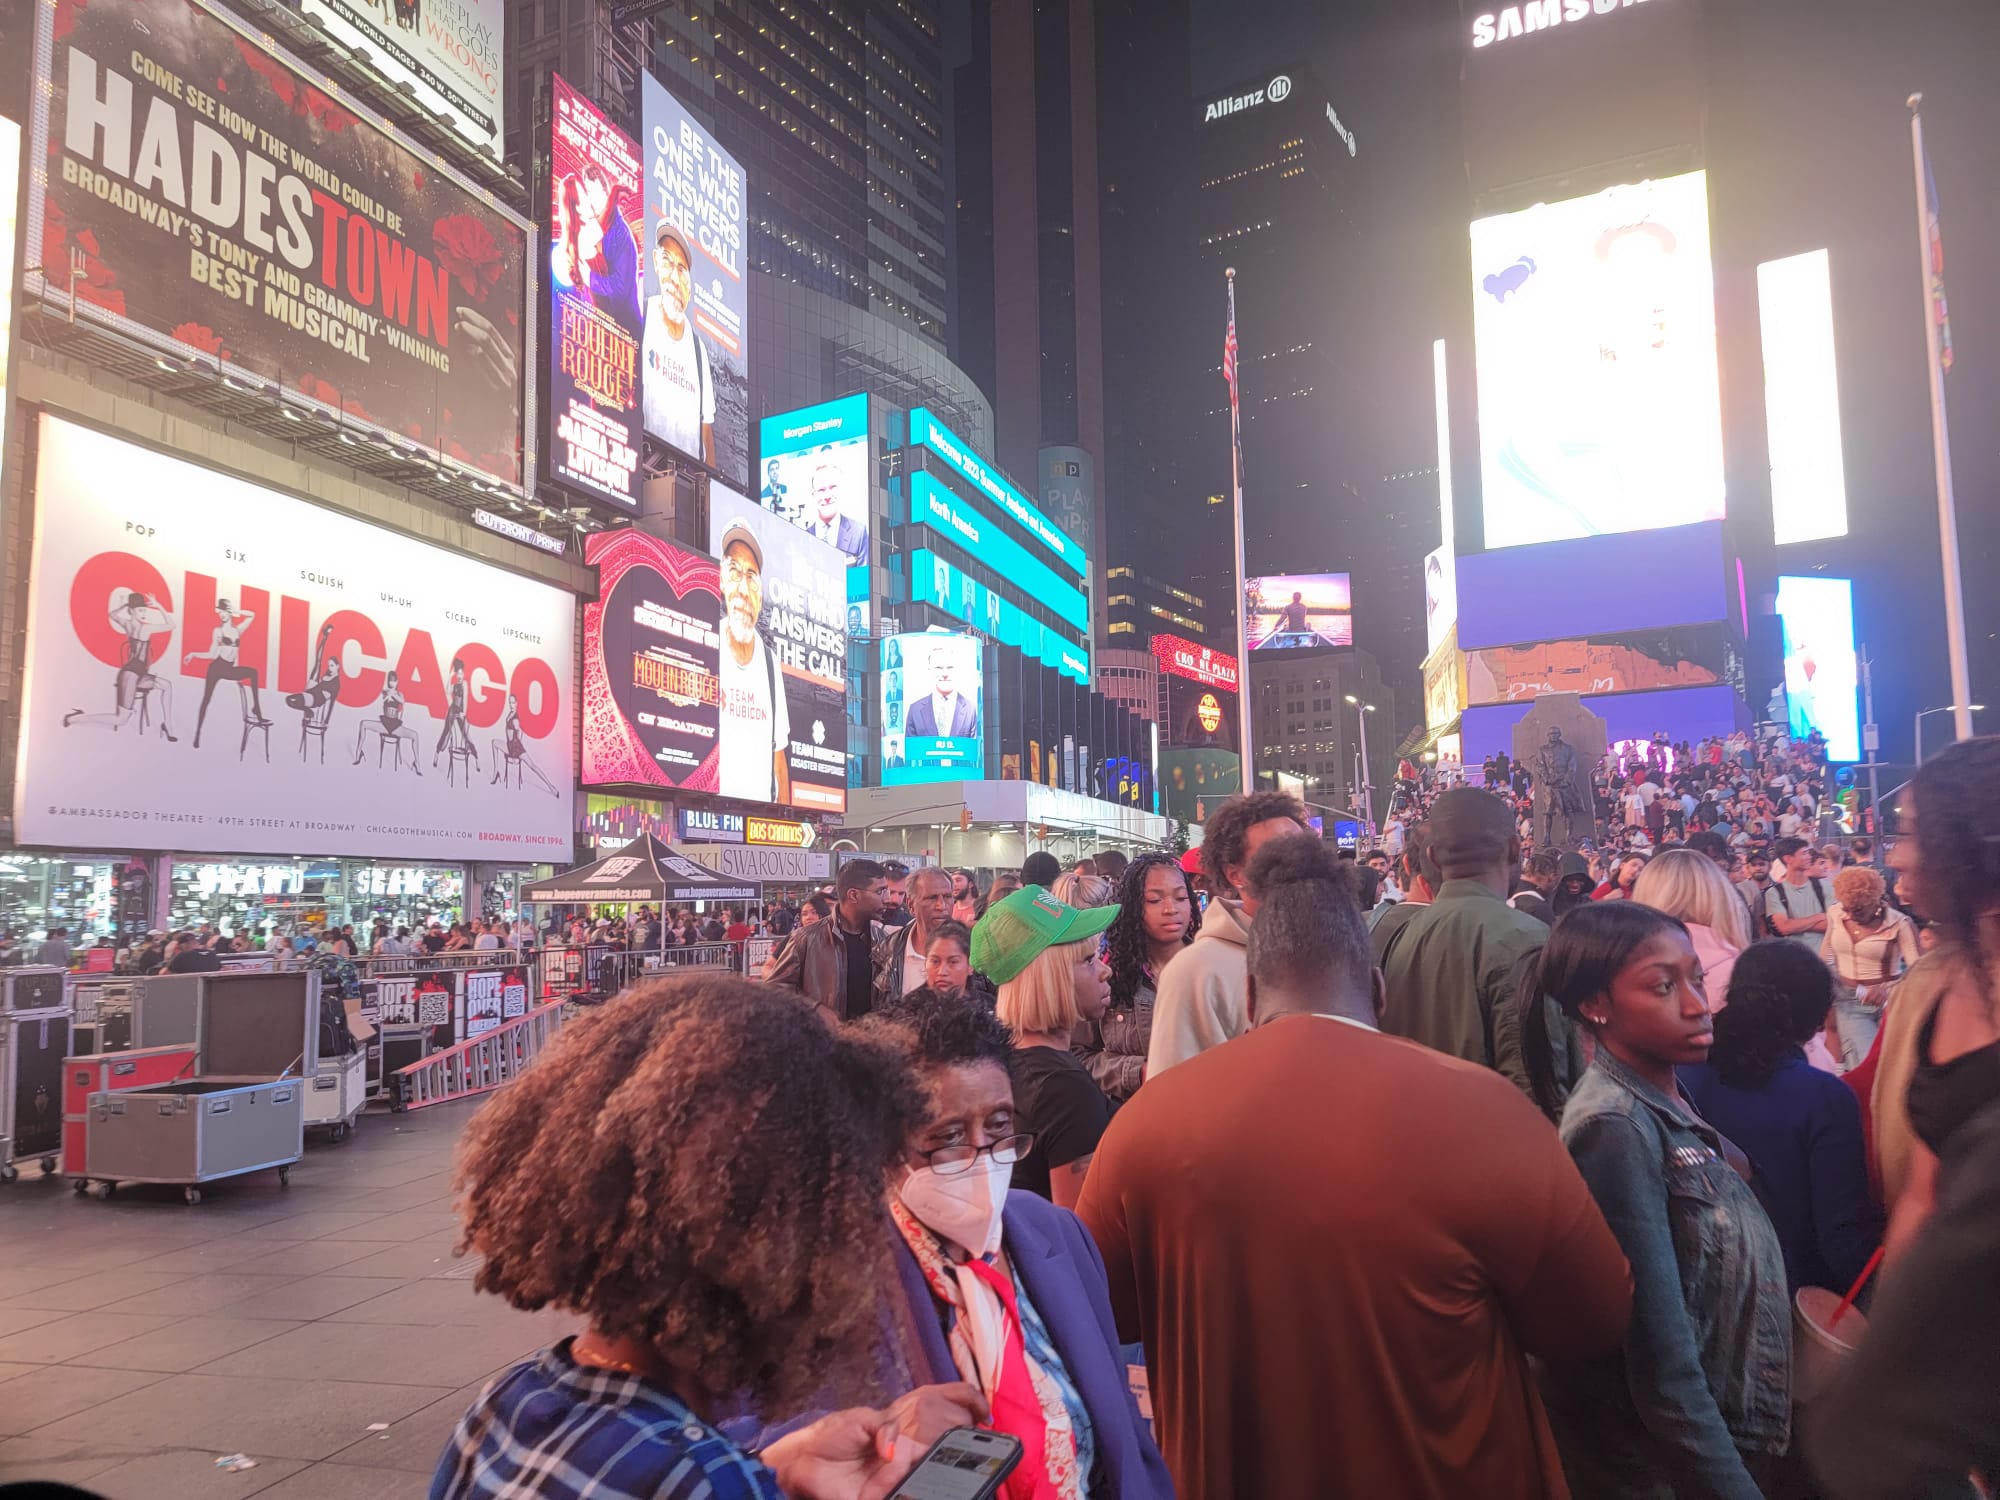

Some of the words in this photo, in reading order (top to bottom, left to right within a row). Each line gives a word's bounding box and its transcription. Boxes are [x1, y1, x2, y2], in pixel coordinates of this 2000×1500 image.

[459, 5, 492, 44] PLAY
[333, 0, 354, 20] NEW
[357, 14, 385, 46] WORLD
[386, 40, 416, 71] STAGES
[419, 63, 435, 86] 340
[435, 80, 447, 96] W.
[463, 100, 488, 128] STREET
[425, 15, 498, 95] WRONG
[459, 26, 498, 70] GOES
[1204, 89, 1264, 122] Allianz
[1326, 102, 1349, 143] Allianz
[131, 50, 182, 101] COME
[187, 83, 216, 120] SEE
[219, 96, 256, 142] HOW
[260, 125, 288, 161] THE
[291, 144, 340, 197] WORLD
[342, 180, 385, 225] COULD
[387, 203, 407, 238] BE.
[680, 119, 704, 163] BE
[708, 146, 740, 198] THE
[653, 126, 694, 181] ONE
[698, 163, 740, 222] WHO
[65, 46, 450, 348] HADESTOWN
[653, 156, 740, 250] ANSWERS
[63, 157, 203, 247] BROADWAY'S
[265, 254, 301, 297] AND
[658, 185, 695, 240] THE
[699, 225, 740, 279] CALL
[191, 254, 258, 306] BEST
[264, 287, 370, 364] MUSICAL
[560, 302, 627, 369] MOULIN
[662, 366, 696, 393] RUBICON
[663, 355, 685, 376] TEAM
[783, 424, 813, 439] Morgan
[929, 422, 963, 467] Welcome
[980, 468, 1006, 504] Summer
[1048, 488, 1090, 512] PLAY
[125, 521, 156, 538] POP
[929, 491, 951, 523] North
[951, 509, 979, 544] America
[1054, 511, 1090, 538] NPR
[225, 548, 246, 564] SIX
[300, 570, 345, 590] SQUISH
[380, 591, 412, 609] UH-UH
[769, 576, 805, 615] ONE
[807, 592, 845, 631] WHO
[445, 610, 477, 627] CICERO
[769, 606, 845, 658] ANSWERS
[69, 551, 559, 739] CHICAGO
[502, 627, 542, 645] LIPSCHITZ
[633, 656, 678, 692] MOULIN
[774, 636, 806, 671] THE
[808, 650, 845, 685] CALL
[1175, 651, 1210, 672] CRONE
[1212, 663, 1236, 680] PLAZA
[729, 687, 755, 704] TEAM
[656, 716, 715, 738] BROADWAY
[729, 703, 767, 721] RUBICON
[60, 807, 148, 820] AMBASSADOR
[155, 812, 204, 824] THEATRE
[218, 816, 245, 826] 49TH
[249, 818, 285, 828] STREET
[289, 820, 300, 829] AT
[304, 821, 356, 832] BROADWAY
[366, 825, 473, 839] CHICAGOTHEMUSICAL.COM
[686, 809, 719, 830] BLUE
[723, 814, 744, 832] FIN
[749, 820, 767, 841] DOS
[769, 822, 803, 844] CAMINOS
[478, 831, 524, 843] BROADWAY.
[525, 835, 546, 845] SINCE
[547, 836, 565, 846] 1996.
[723, 848, 808, 877] SWAROVSKI
[468, 977, 502, 1000] HOPE
[468, 998, 502, 1021] OVER
